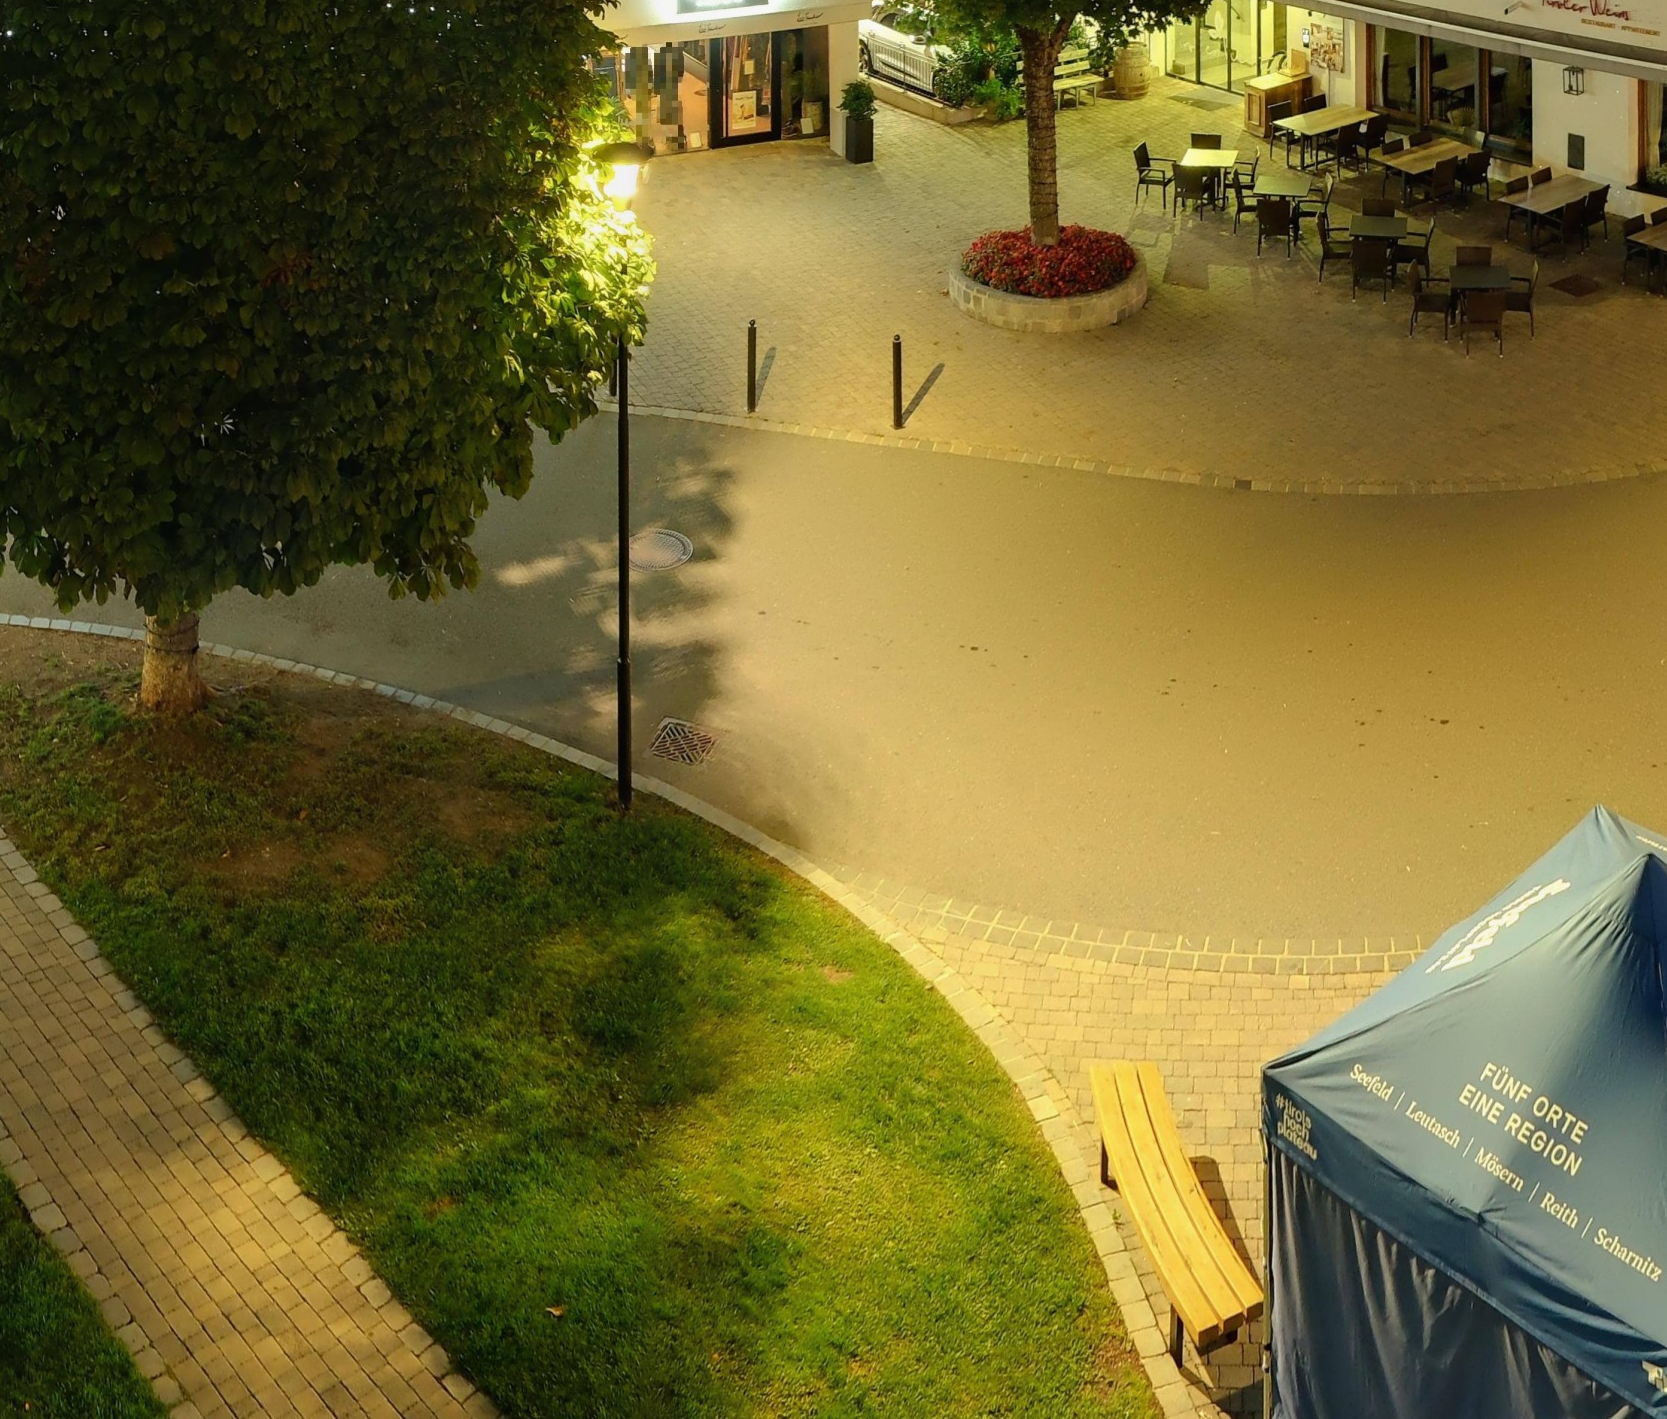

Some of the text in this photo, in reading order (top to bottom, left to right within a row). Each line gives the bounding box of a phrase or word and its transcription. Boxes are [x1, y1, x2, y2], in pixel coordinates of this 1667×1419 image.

[1275, 1093, 1312, 1129] #tirols
[1277, 1122, 1318, 1161] plateau
[1459, 1083, 1583, 1176] EINE REGION
[1480, 1062, 1588, 1144] FÜNF ORTE
[1350, 1063, 1663, 1282] Seefeld Leutasch Mösern Reith Scharnitz
